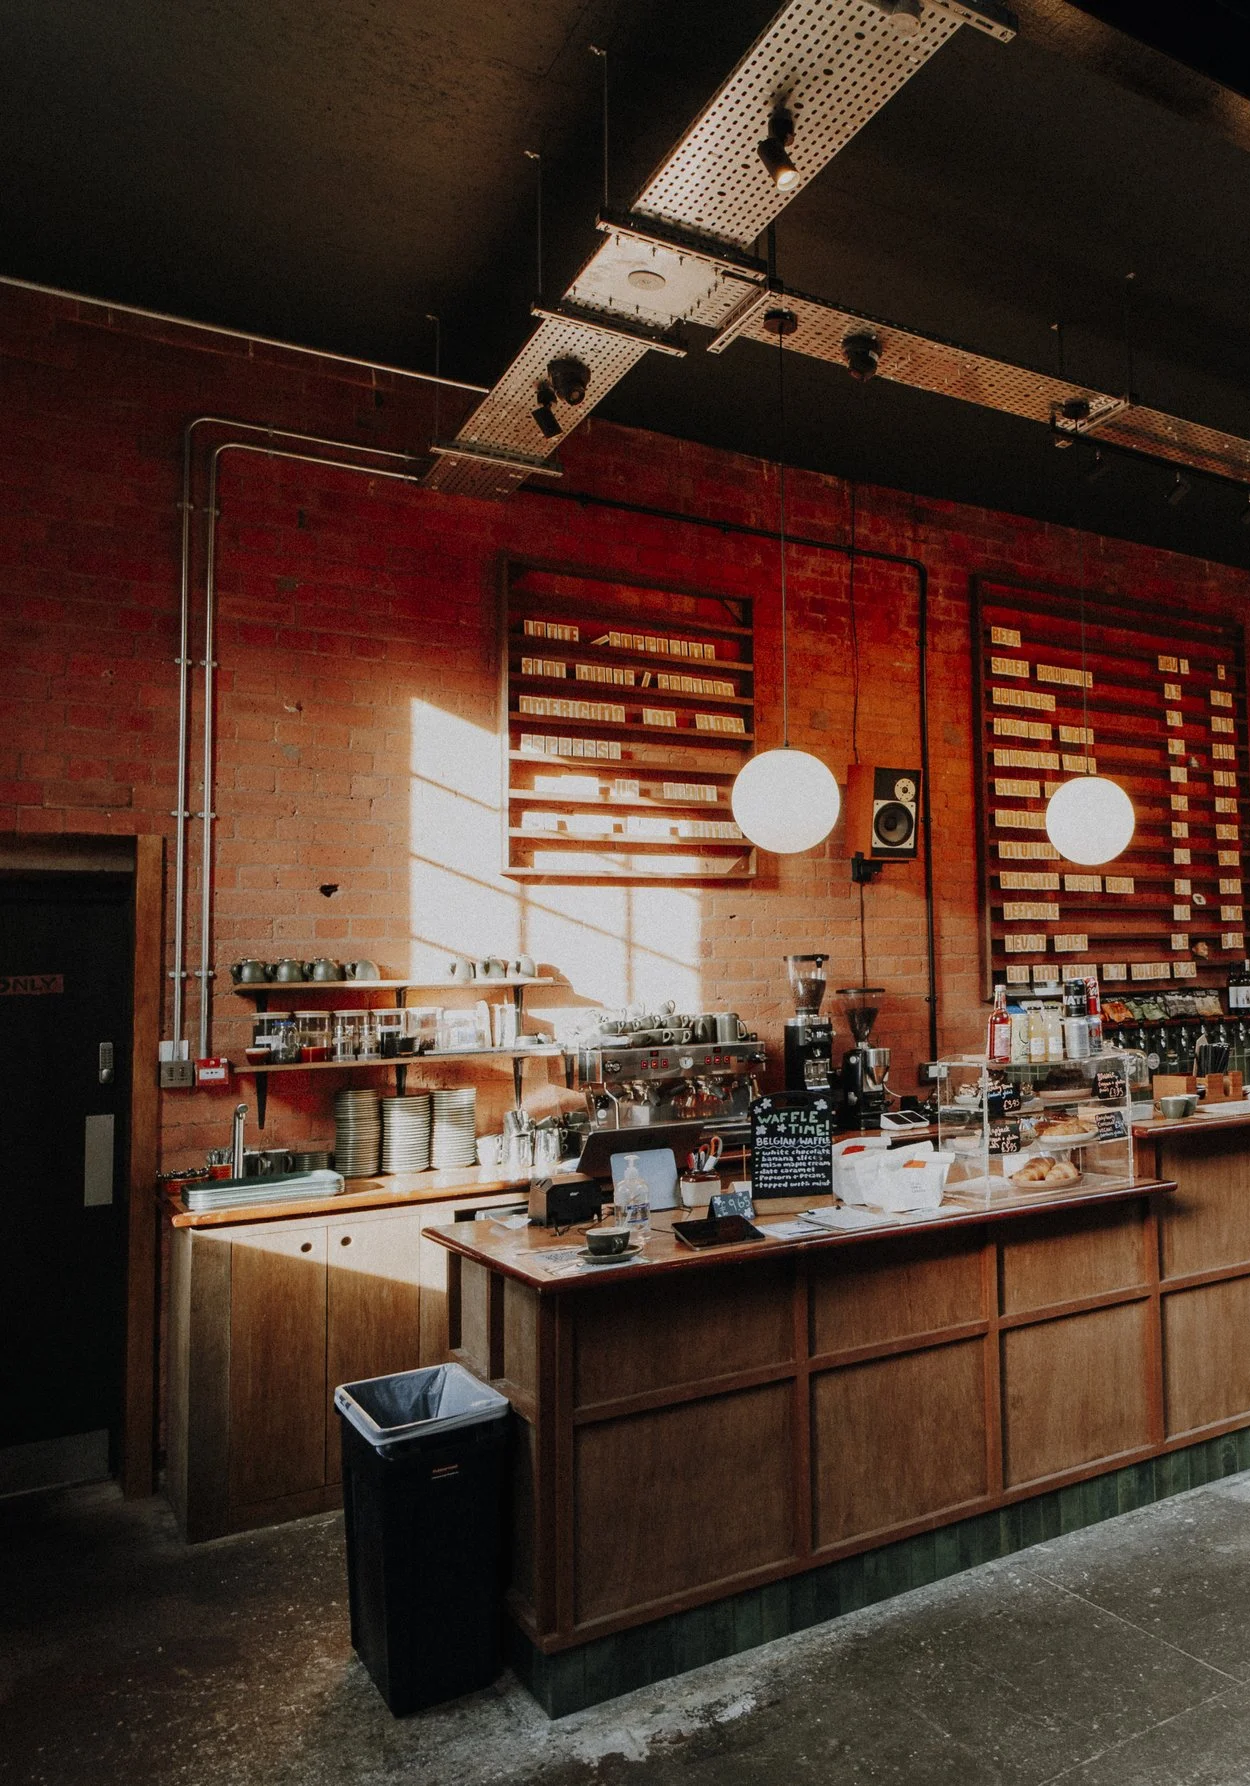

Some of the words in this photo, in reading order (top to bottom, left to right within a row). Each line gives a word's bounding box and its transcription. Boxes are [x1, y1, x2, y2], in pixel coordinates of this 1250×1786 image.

[992, 627, 1021, 647] BEER
[575, 664, 635, 686] WHITE
[992, 657, 1029, 678] SOBER
[519, 695, 625, 723] AMERICANO
[992, 687, 1056, 712] GUINNESS
[680, 820, 742, 839] RINKS
[1005, 934, 1046, 952] DEVON
[1054, 934, 1088, 952] CIDER
[1006, 965, 1030, 983] GIN
[757, 1111, 818, 1124] WAFFLE
[788, 1120, 830, 1136] TIME!
[756, 1137, 796, 1146] BELGIAN
[799, 1136, 831, 1145] WAFFLE
